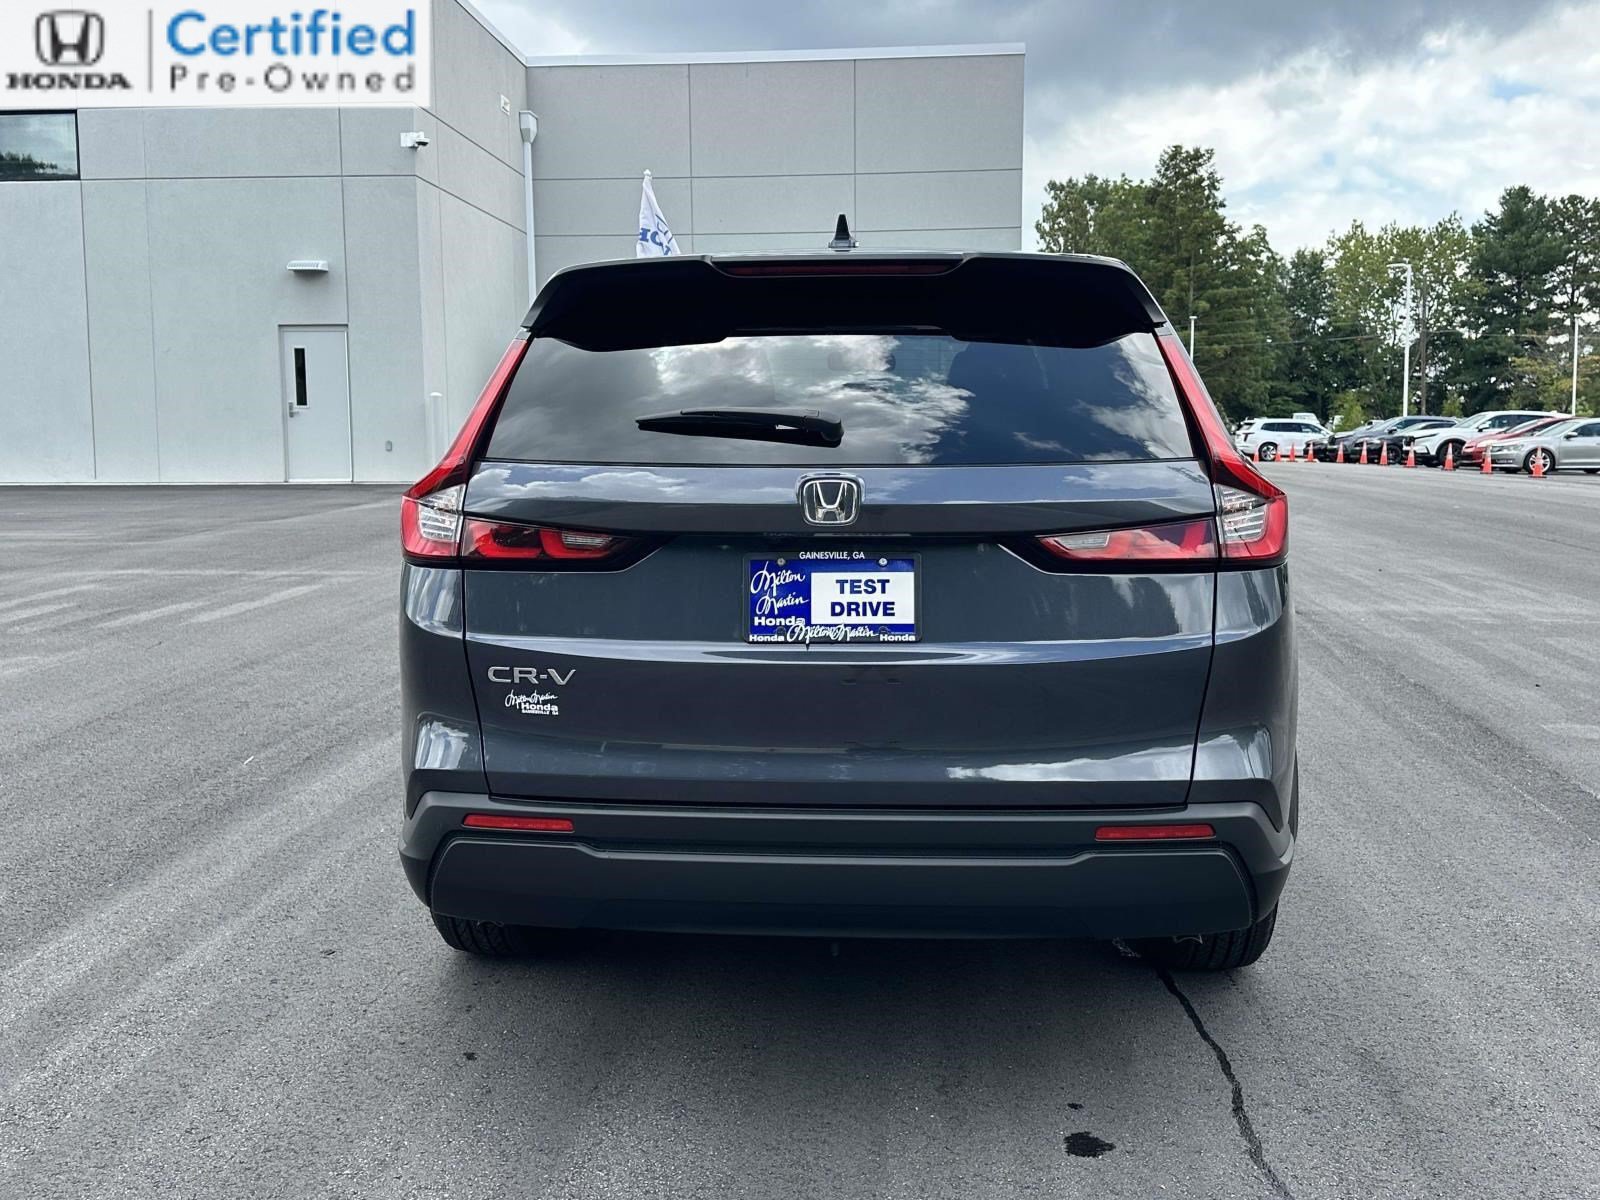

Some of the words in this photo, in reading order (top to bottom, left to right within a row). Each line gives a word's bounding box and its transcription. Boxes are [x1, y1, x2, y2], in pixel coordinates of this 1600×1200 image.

[750, 561, 805, 596] Milton
[835, 579, 890, 594] TEST
[830, 601, 895, 617] DRIVE
[754, 616, 806, 626] Honda
[750, 634, 785, 642] Honda
[487, 666, 577, 686] CR-V
[521, 703, 558, 711] Honda
